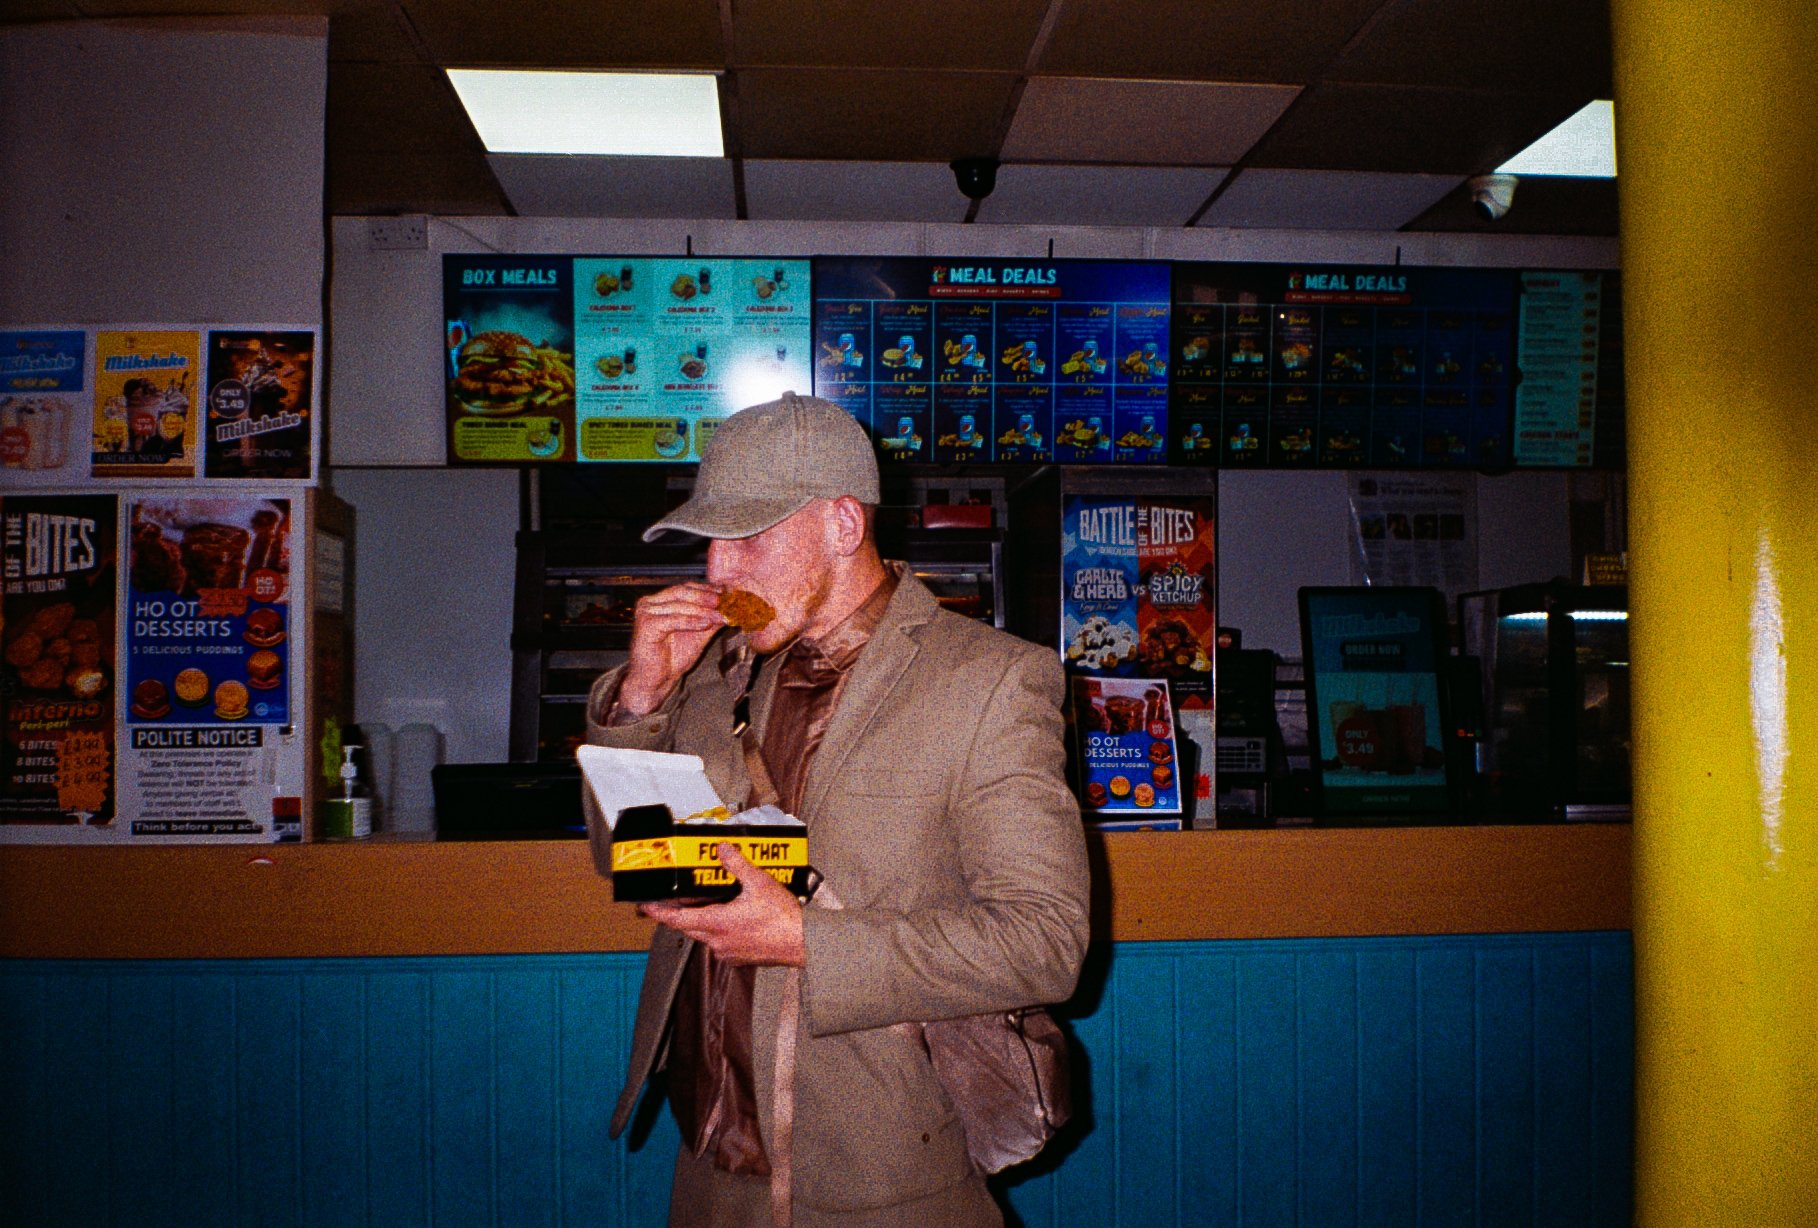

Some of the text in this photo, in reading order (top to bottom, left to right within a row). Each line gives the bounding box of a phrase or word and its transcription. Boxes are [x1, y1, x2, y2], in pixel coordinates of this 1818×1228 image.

[463, 269, 557, 284] BOX MEALS
[949, 267, 1057, 285] MEAL DEALS
[1305, 274, 1407, 292] MEAL DEALS
[105, 353, 188, 372] Milkshake
[219, 388, 242, 397] ONLY
[216, 409, 302, 442] Milkshake
[97, 452, 166, 463] ORDER NOW
[222, 447, 293, 458] ORDER NOW
[1079, 505, 1135, 545] BATTLE
[1137, 506, 1148, 546] OF THE
[1150, 506, 1194, 545] BITES
[4, 512, 23, 578] OF THE
[25, 512, 97, 576] BITES
[255, 576, 274, 585] HO
[1076, 568, 1124, 585] GARLIC
[1151, 574, 1202, 592] SPICY
[5, 580, 24, 594] ARE
[26, 579, 47, 593] YOU
[1073, 584, 1128, 600] & HERB
[1152, 591, 1202, 604] KETCHUP
[135, 601, 199, 617] HO OT
[134, 620, 232, 637] DESSERTS
[142, 645, 192, 655] DELICIOUS
[195, 645, 244, 655] PUDDINGS
[1344, 643, 1376, 656] ORDER
[137, 729, 257, 746] POLITE NOTICE
[1103, 737, 1121, 746] OT
[1344, 729, 1369, 739] ONLY
[18, 740, 57, 750] 6 BITES
[1084, 748, 1142, 758] DESSERTS
[25, 757, 56, 767] BITES
[151, 760, 242, 769] Zero Tolerance Policy
[25, 773, 56, 784] BITES
[186, 779, 204, 787] NOT
[134, 822, 168, 832] Think
[170, 822, 210, 832] before
[213, 823, 235, 834] you
[699, 843, 790, 861] FO THAT
